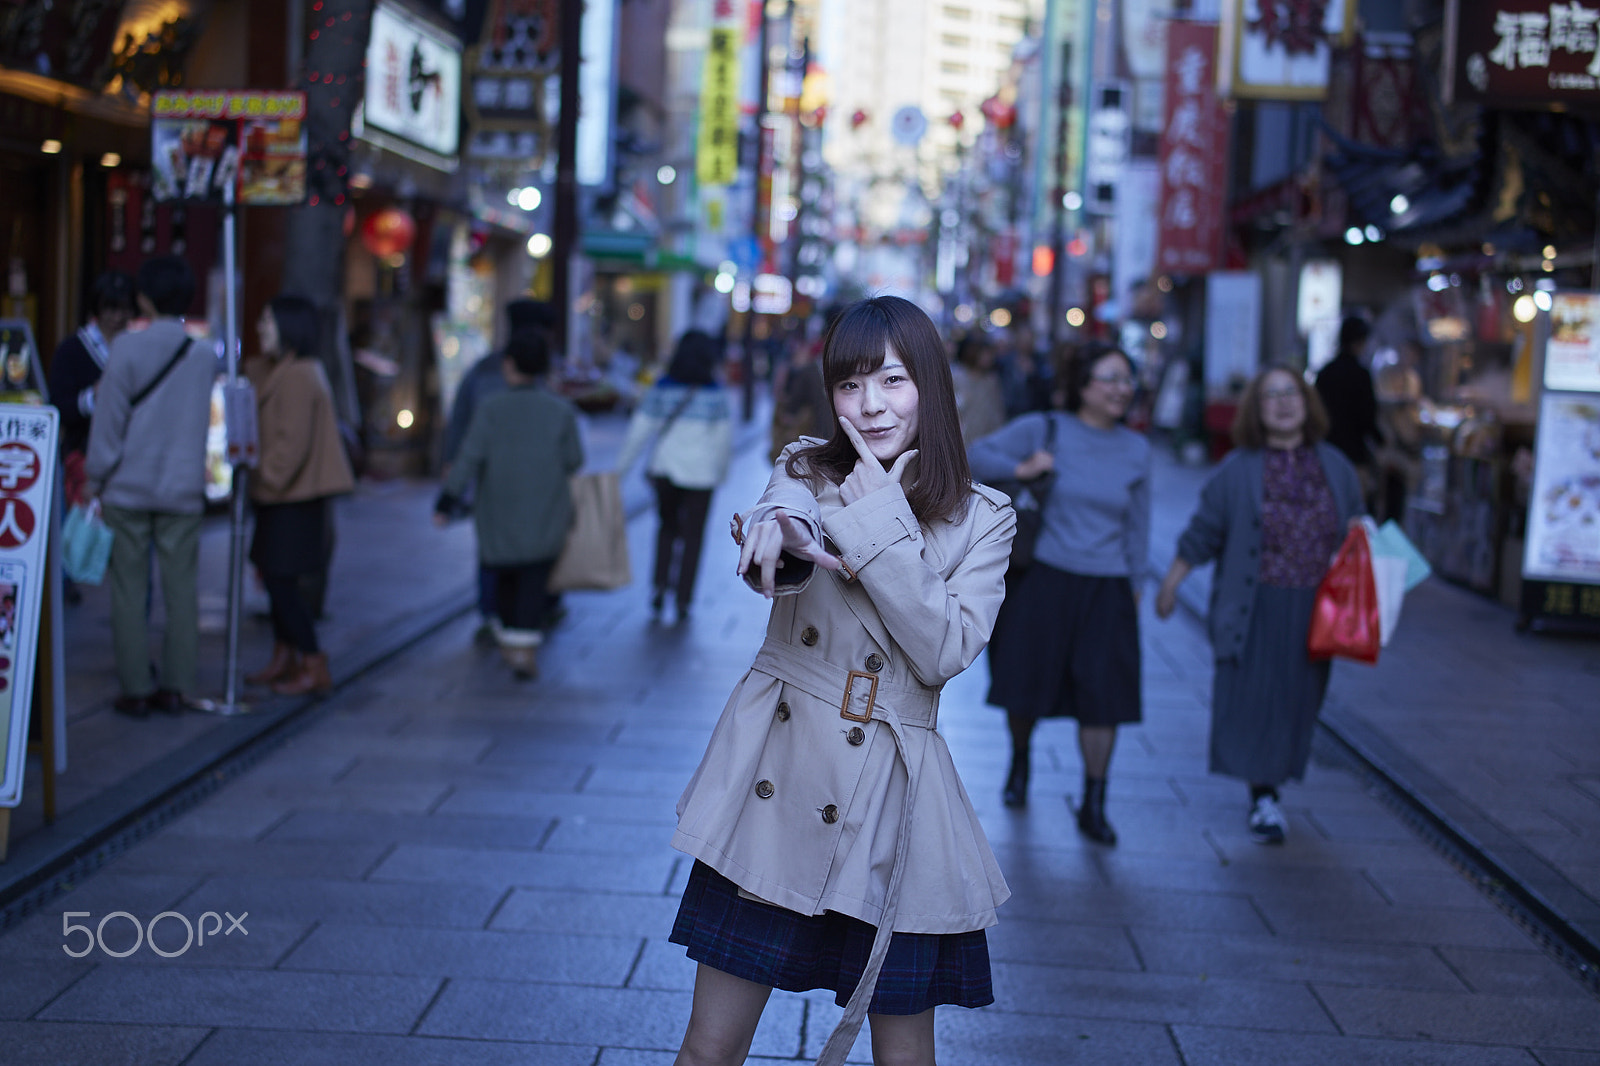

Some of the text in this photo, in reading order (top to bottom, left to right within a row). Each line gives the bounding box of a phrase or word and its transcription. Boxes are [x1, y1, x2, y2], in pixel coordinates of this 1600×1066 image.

[1488, 0, 1600, 77] 福臨
[0, 416, 48, 441] 作家
[0, 446, 36, 490] 字
[0, 500, 28, 545] 人
